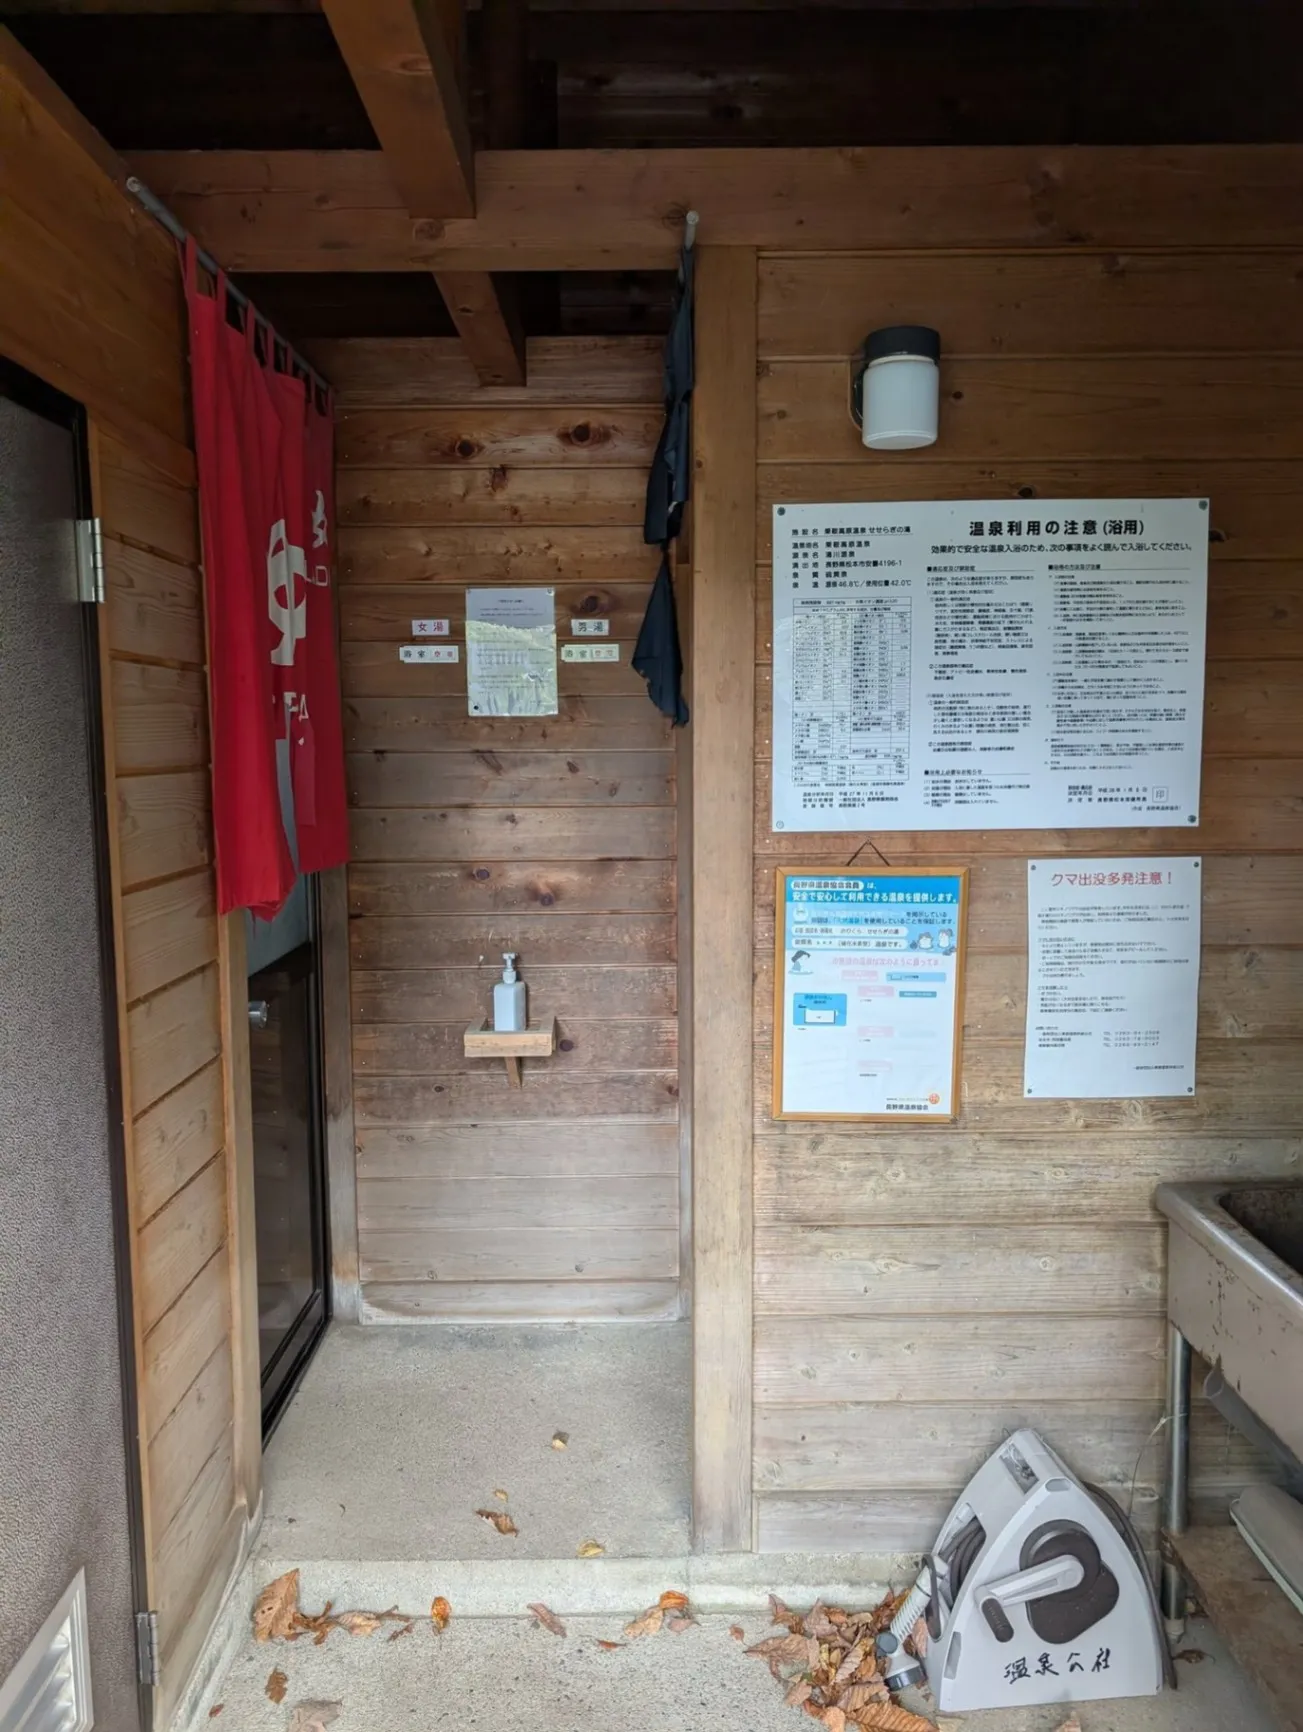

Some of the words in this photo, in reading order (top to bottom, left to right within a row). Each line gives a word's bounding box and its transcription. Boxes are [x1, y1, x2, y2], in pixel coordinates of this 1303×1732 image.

[969, 520, 1098, 537] 温泉利用の注意
[1103, 520, 1144, 536] (浴用)
[417, 621, 444, 633] 女湯
[1051, 871, 1172, 887] クマ出没多発注意!
[792, 891, 956, 903] 安全で安心して利用できる温泉を提供します。
[1003, 1647, 1111, 1685] 温泉公社
